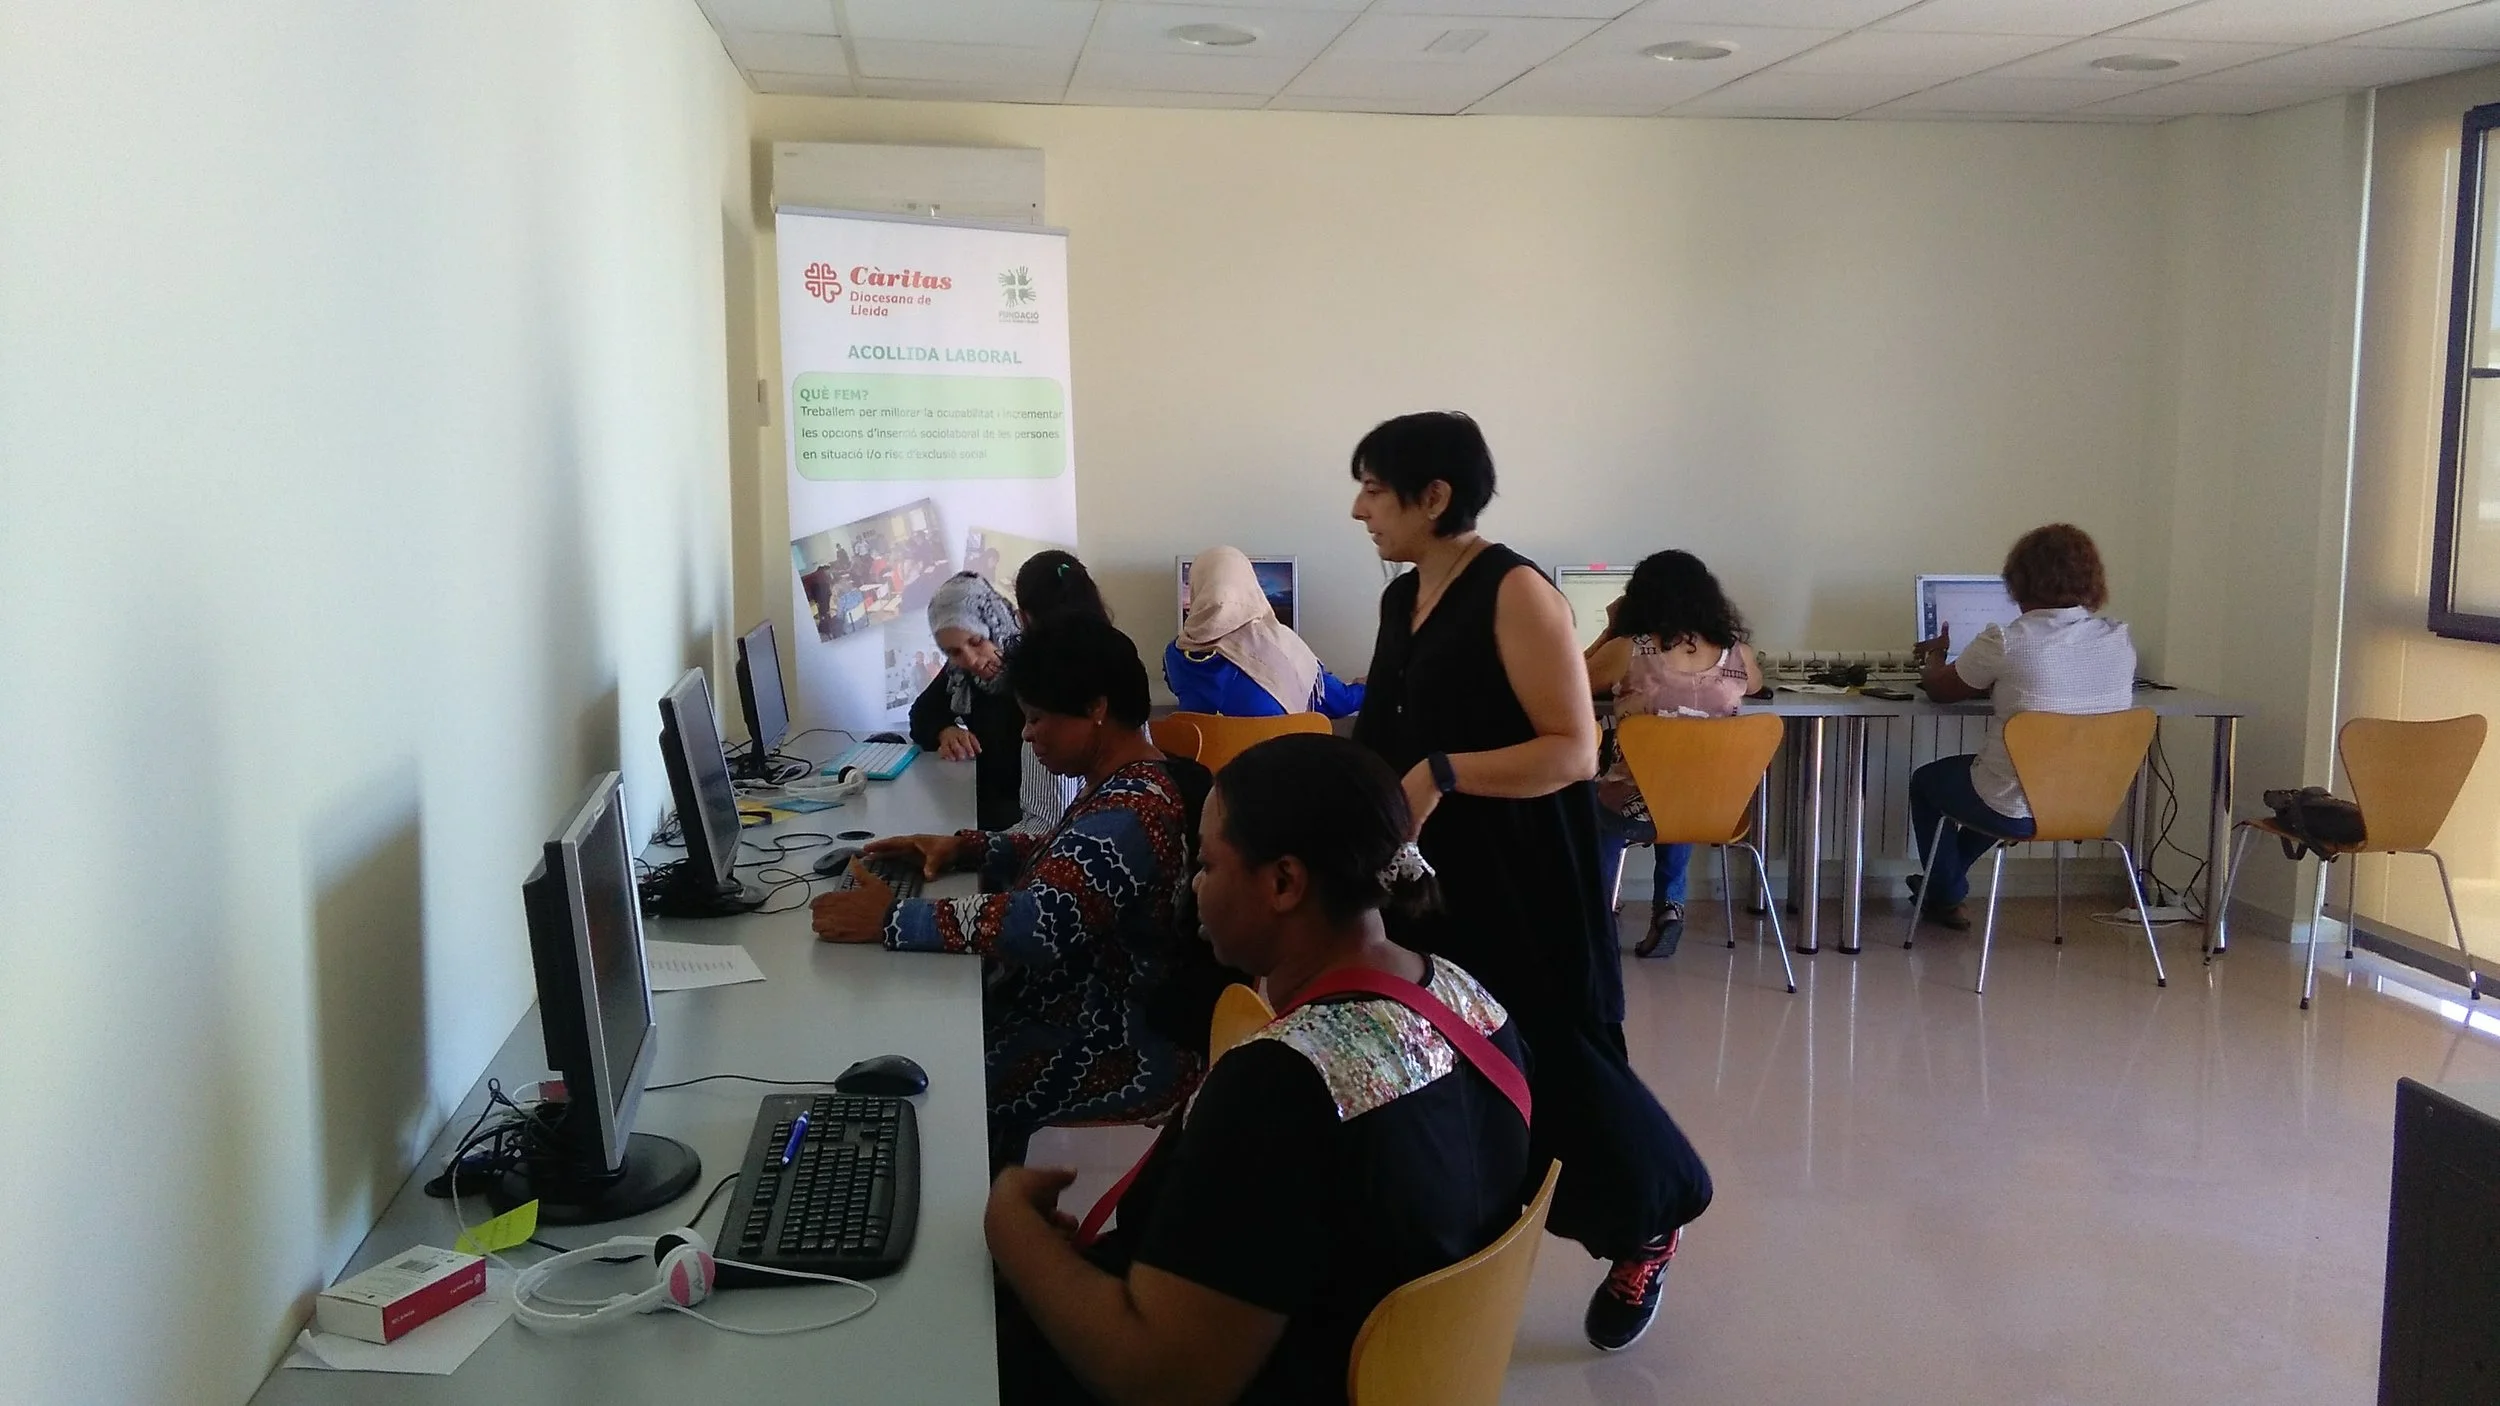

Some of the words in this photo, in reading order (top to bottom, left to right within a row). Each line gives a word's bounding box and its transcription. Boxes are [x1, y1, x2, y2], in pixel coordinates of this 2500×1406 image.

[850, 266, 952, 290] Càritas
[850, 291, 913, 304] Diocesana
[917, 295, 932, 305] de
[851, 304, 888, 316] Lleida
[848, 345, 939, 361] ACOLLIDA
[945, 347, 1022, 364] LABORAL
[800, 386, 829, 402] QUÈ
[834, 389, 869, 401] FEM?
[801, 405, 856, 417] Treballem
[859, 408, 877, 418] per
[880, 407, 920, 417] millorar
[924, 407, 933, 418] la
[802, 428, 818, 438] les
[822, 428, 864, 440] opcions
[920, 429, 979, 439] sociolaboral
[1014, 430, 1060, 441] persones
[802, 450, 817, 459] en
[821, 447, 863, 459] situació
